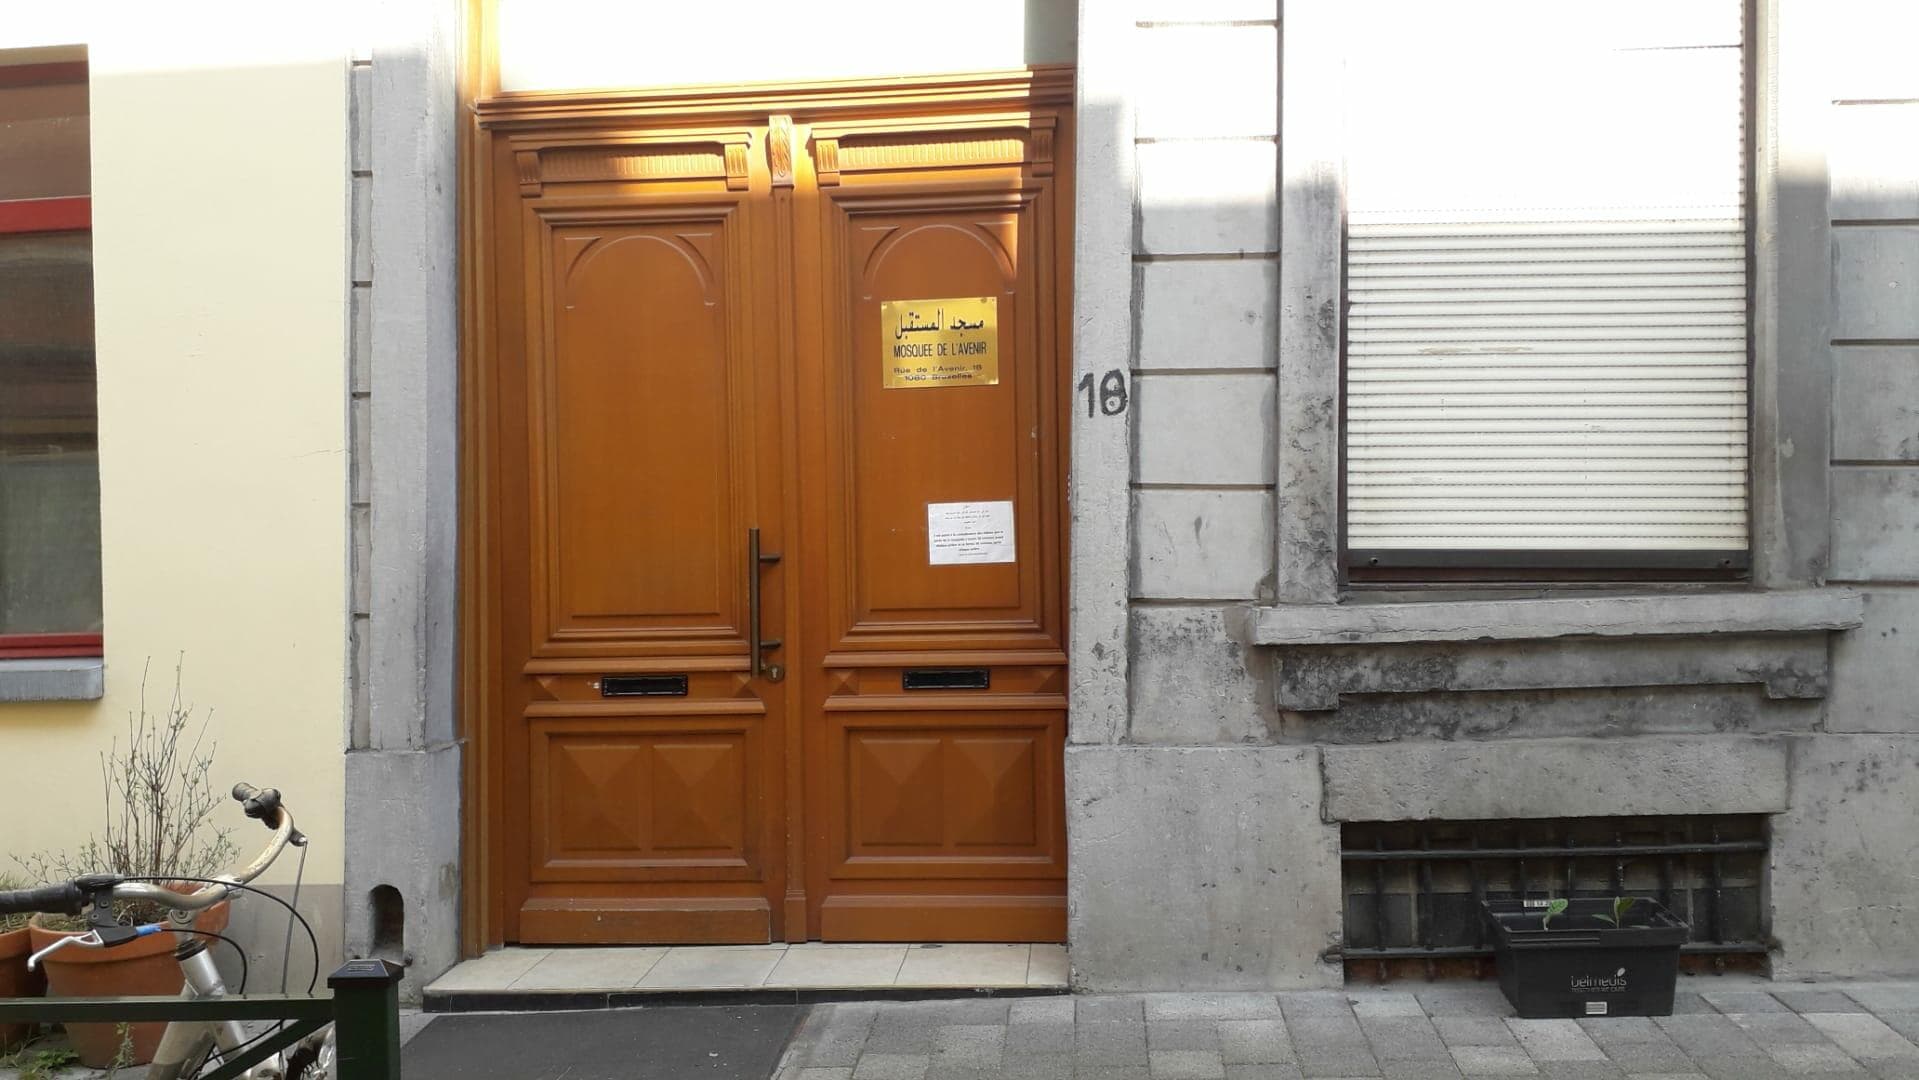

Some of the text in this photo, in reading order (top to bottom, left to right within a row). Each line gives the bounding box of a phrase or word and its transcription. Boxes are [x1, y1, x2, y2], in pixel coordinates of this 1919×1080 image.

[895, 308, 984, 340] مسجد المستقبل
[893, 341, 987, 358] MOSQUEE DE L'AVENIR
[893, 366, 910, 375] Rue
[932, 372, 973, 381] Bruxelles
[1078, 368, 1128, 418] 18
